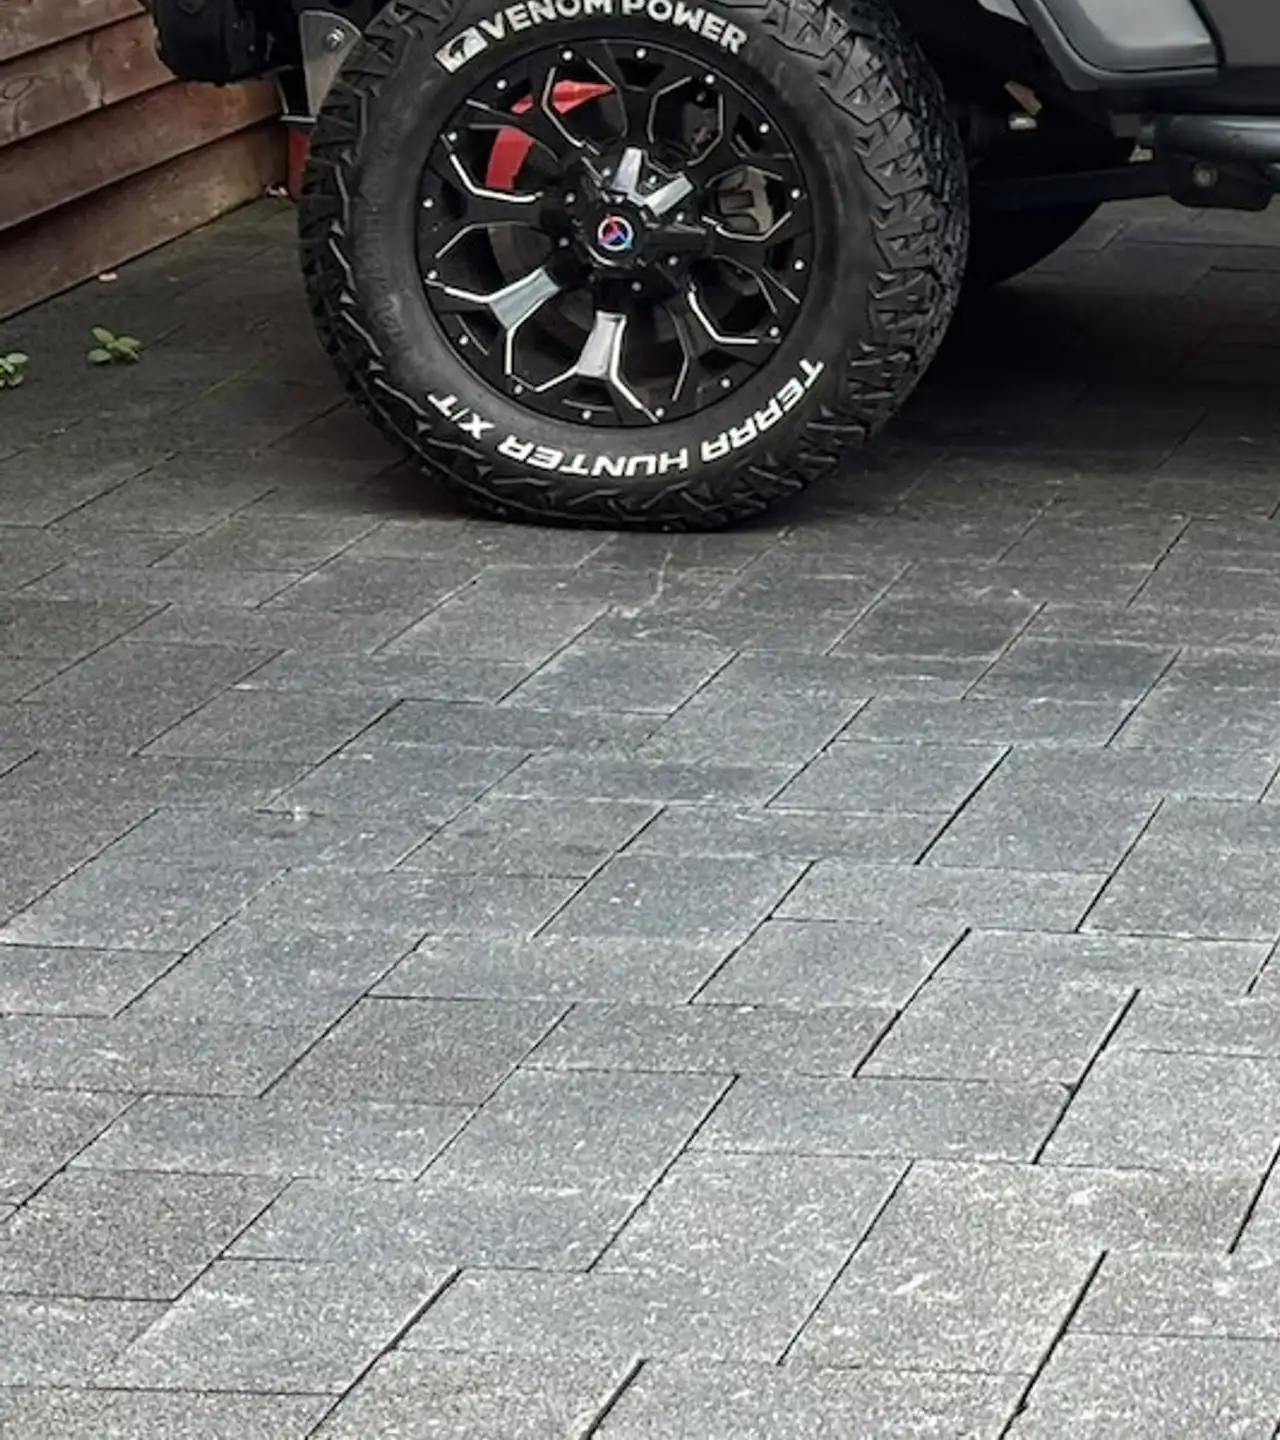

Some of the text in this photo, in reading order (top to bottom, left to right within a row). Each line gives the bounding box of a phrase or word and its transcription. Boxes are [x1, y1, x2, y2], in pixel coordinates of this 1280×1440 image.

[427, 358, 825, 478] TERRA HUNTER X/T
